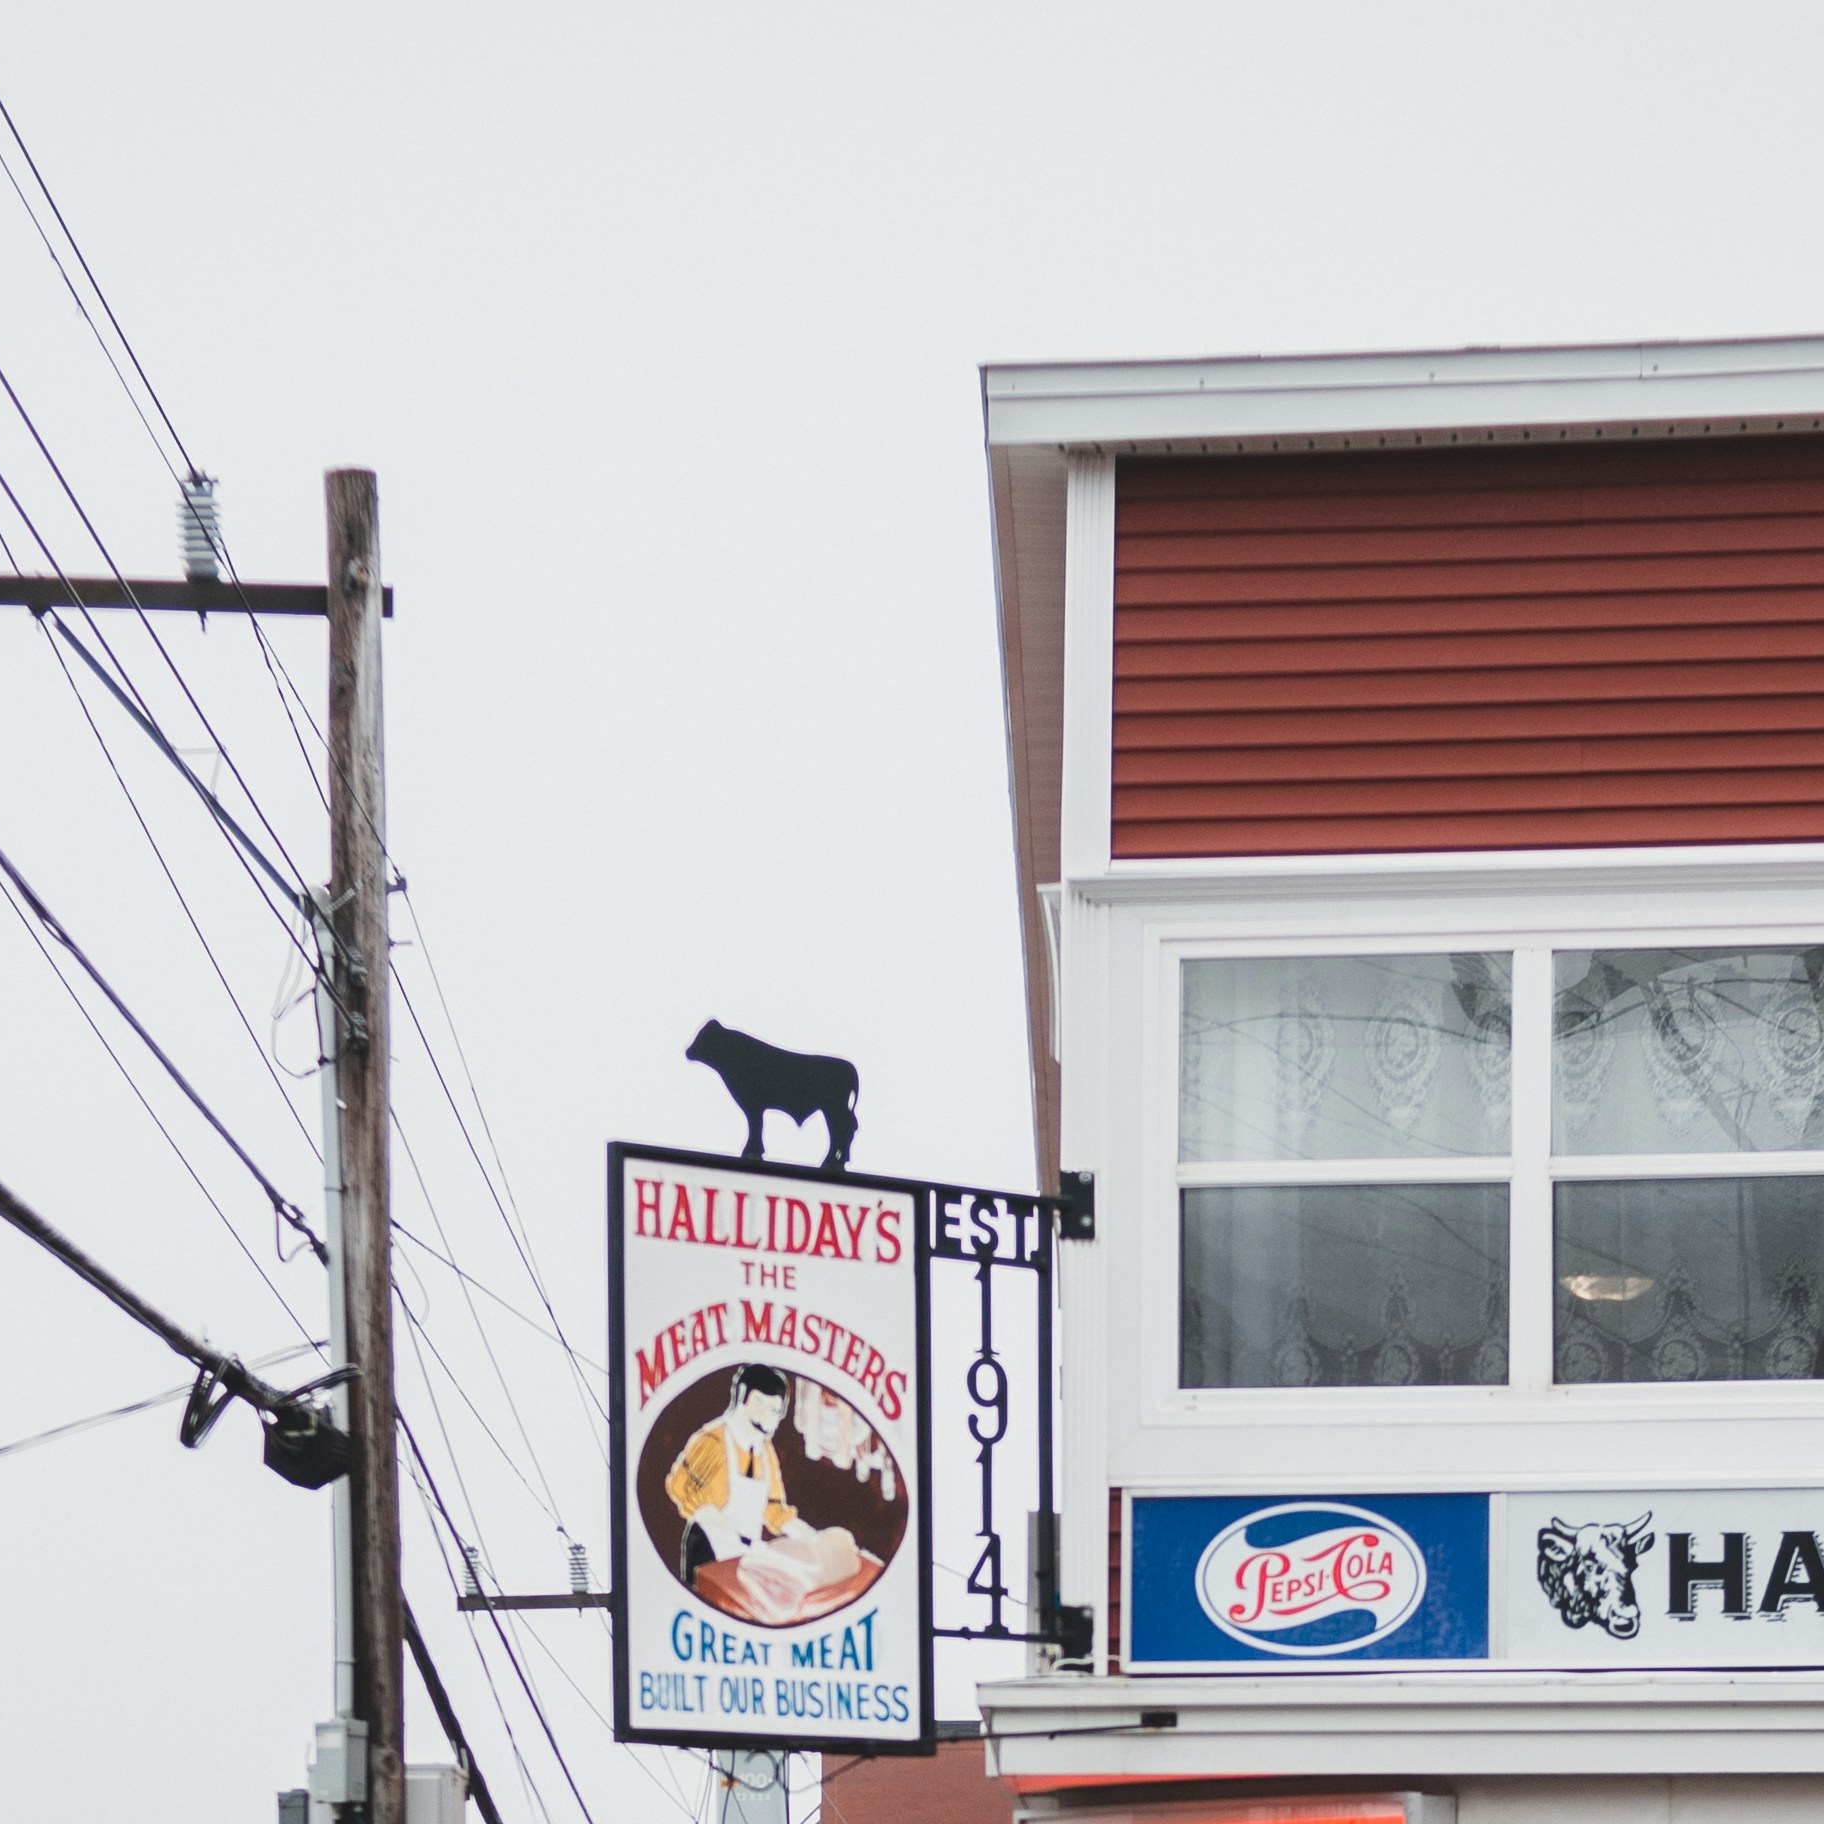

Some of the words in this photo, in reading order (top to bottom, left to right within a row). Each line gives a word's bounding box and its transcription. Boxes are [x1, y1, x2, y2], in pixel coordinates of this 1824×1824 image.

[634, 1179, 902, 1264] HALLIDAY'S
[944, 1200, 1039, 1258] EST
[742, 1262, 796, 1290] THE
[636, 1303, 728, 1410] MEAT
[741, 1300, 908, 1421] MASTERS
[672, 1610, 771, 1667] GREAT
[791, 1607, 879, 1672] MEAT
[639, 1673, 706, 1714] BUILT
[719, 1677, 766, 1718] OUR
[776, 1680, 909, 1723] BUSINESS
